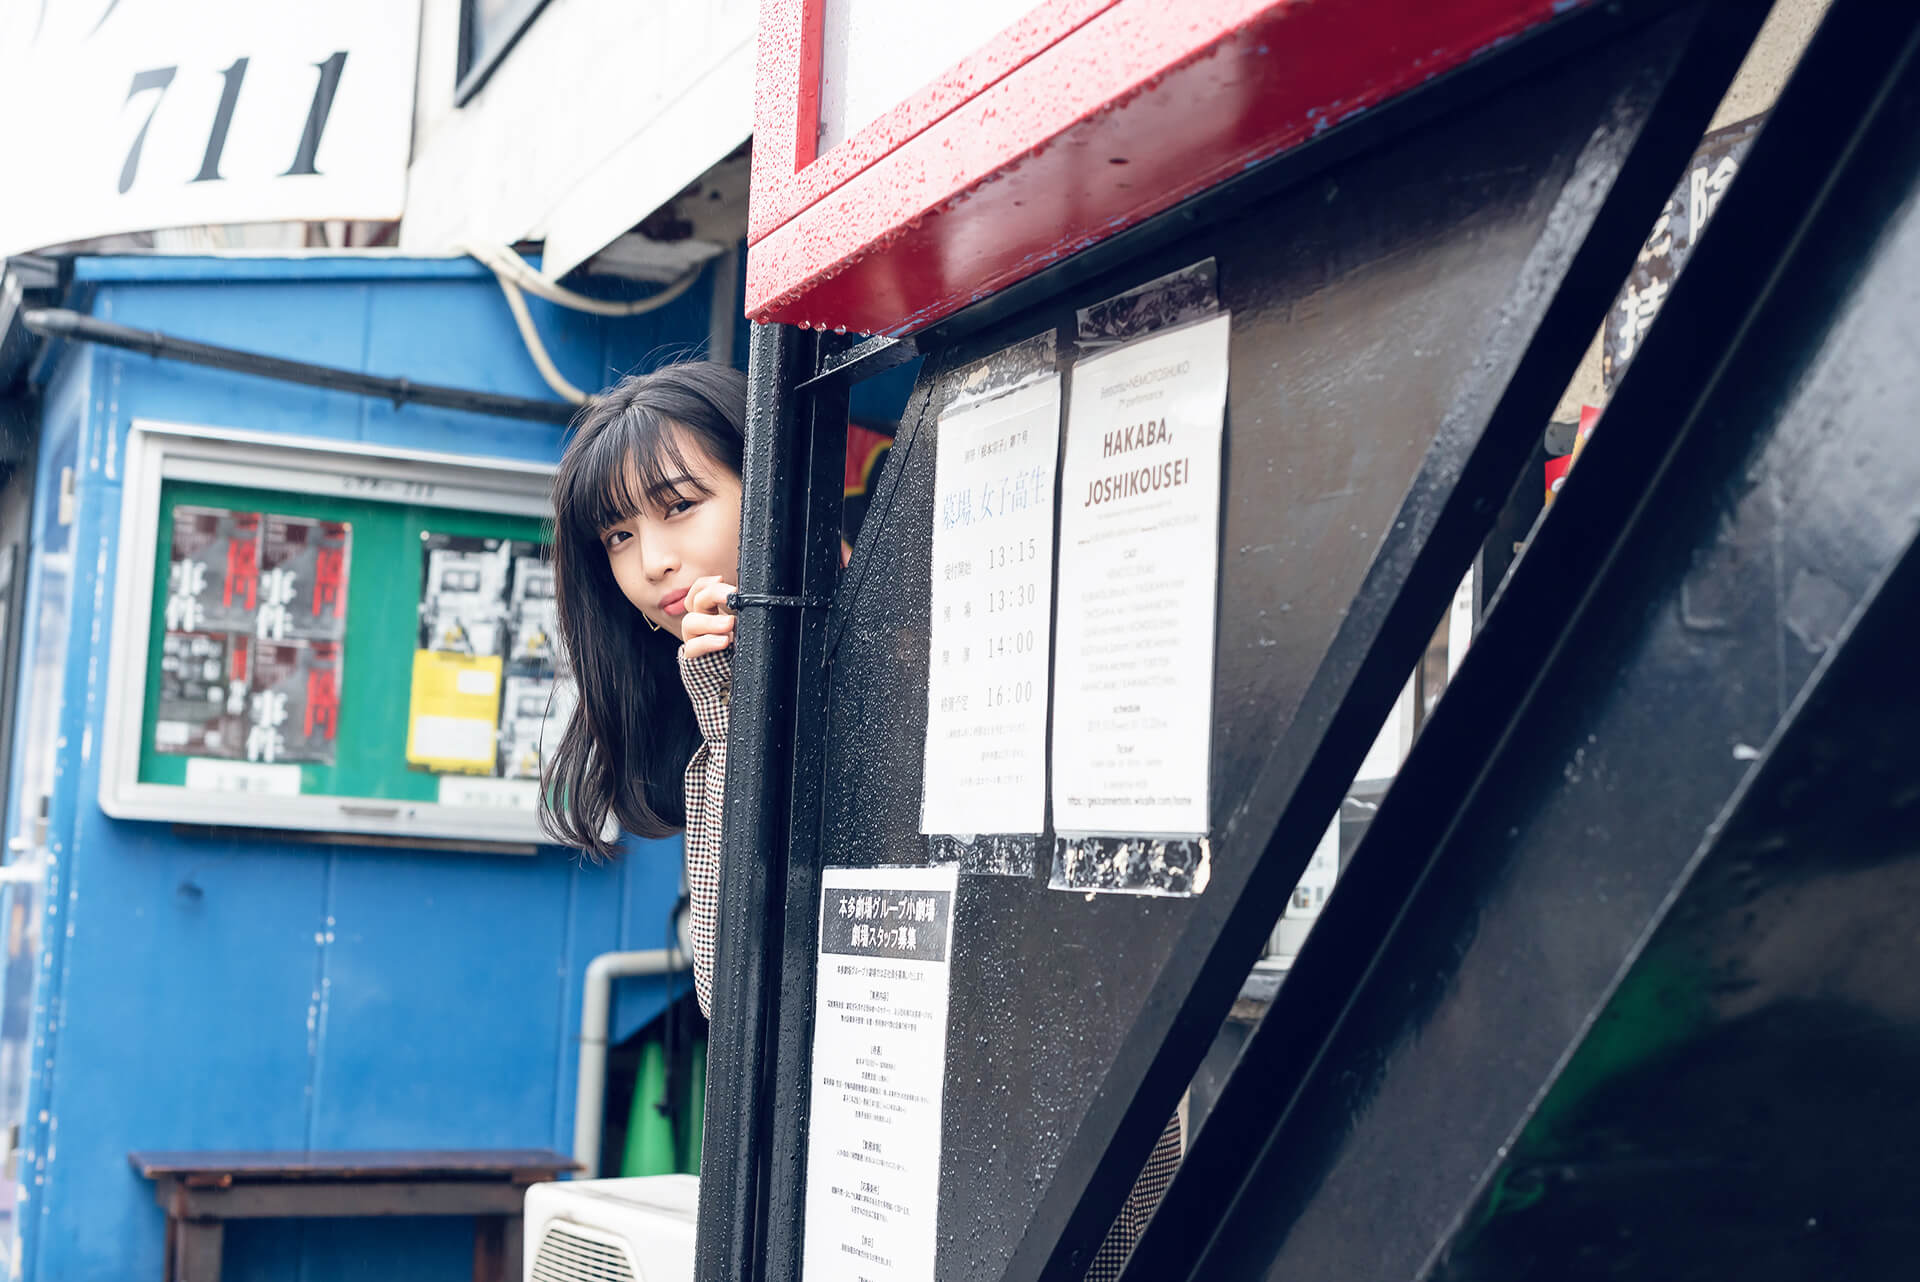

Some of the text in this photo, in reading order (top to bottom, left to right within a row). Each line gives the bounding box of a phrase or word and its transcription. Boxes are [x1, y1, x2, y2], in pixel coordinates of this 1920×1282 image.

[117, 51, 349, 195] 711
[1103, 417, 1173, 458] HAKABA,
[1084, 457, 1189, 507] JOSHIKOUSEI
[989, 538, 1036, 570] 13:15
[989, 583, 1035, 613] 13:30
[988, 629, 1034, 658] 14:00
[988, 681, 1032, 707] 16:00
[838, 895, 936, 922] 本多劇場グループ小劇場
[850, 924, 917, 950] 劇場スタッフ募集
